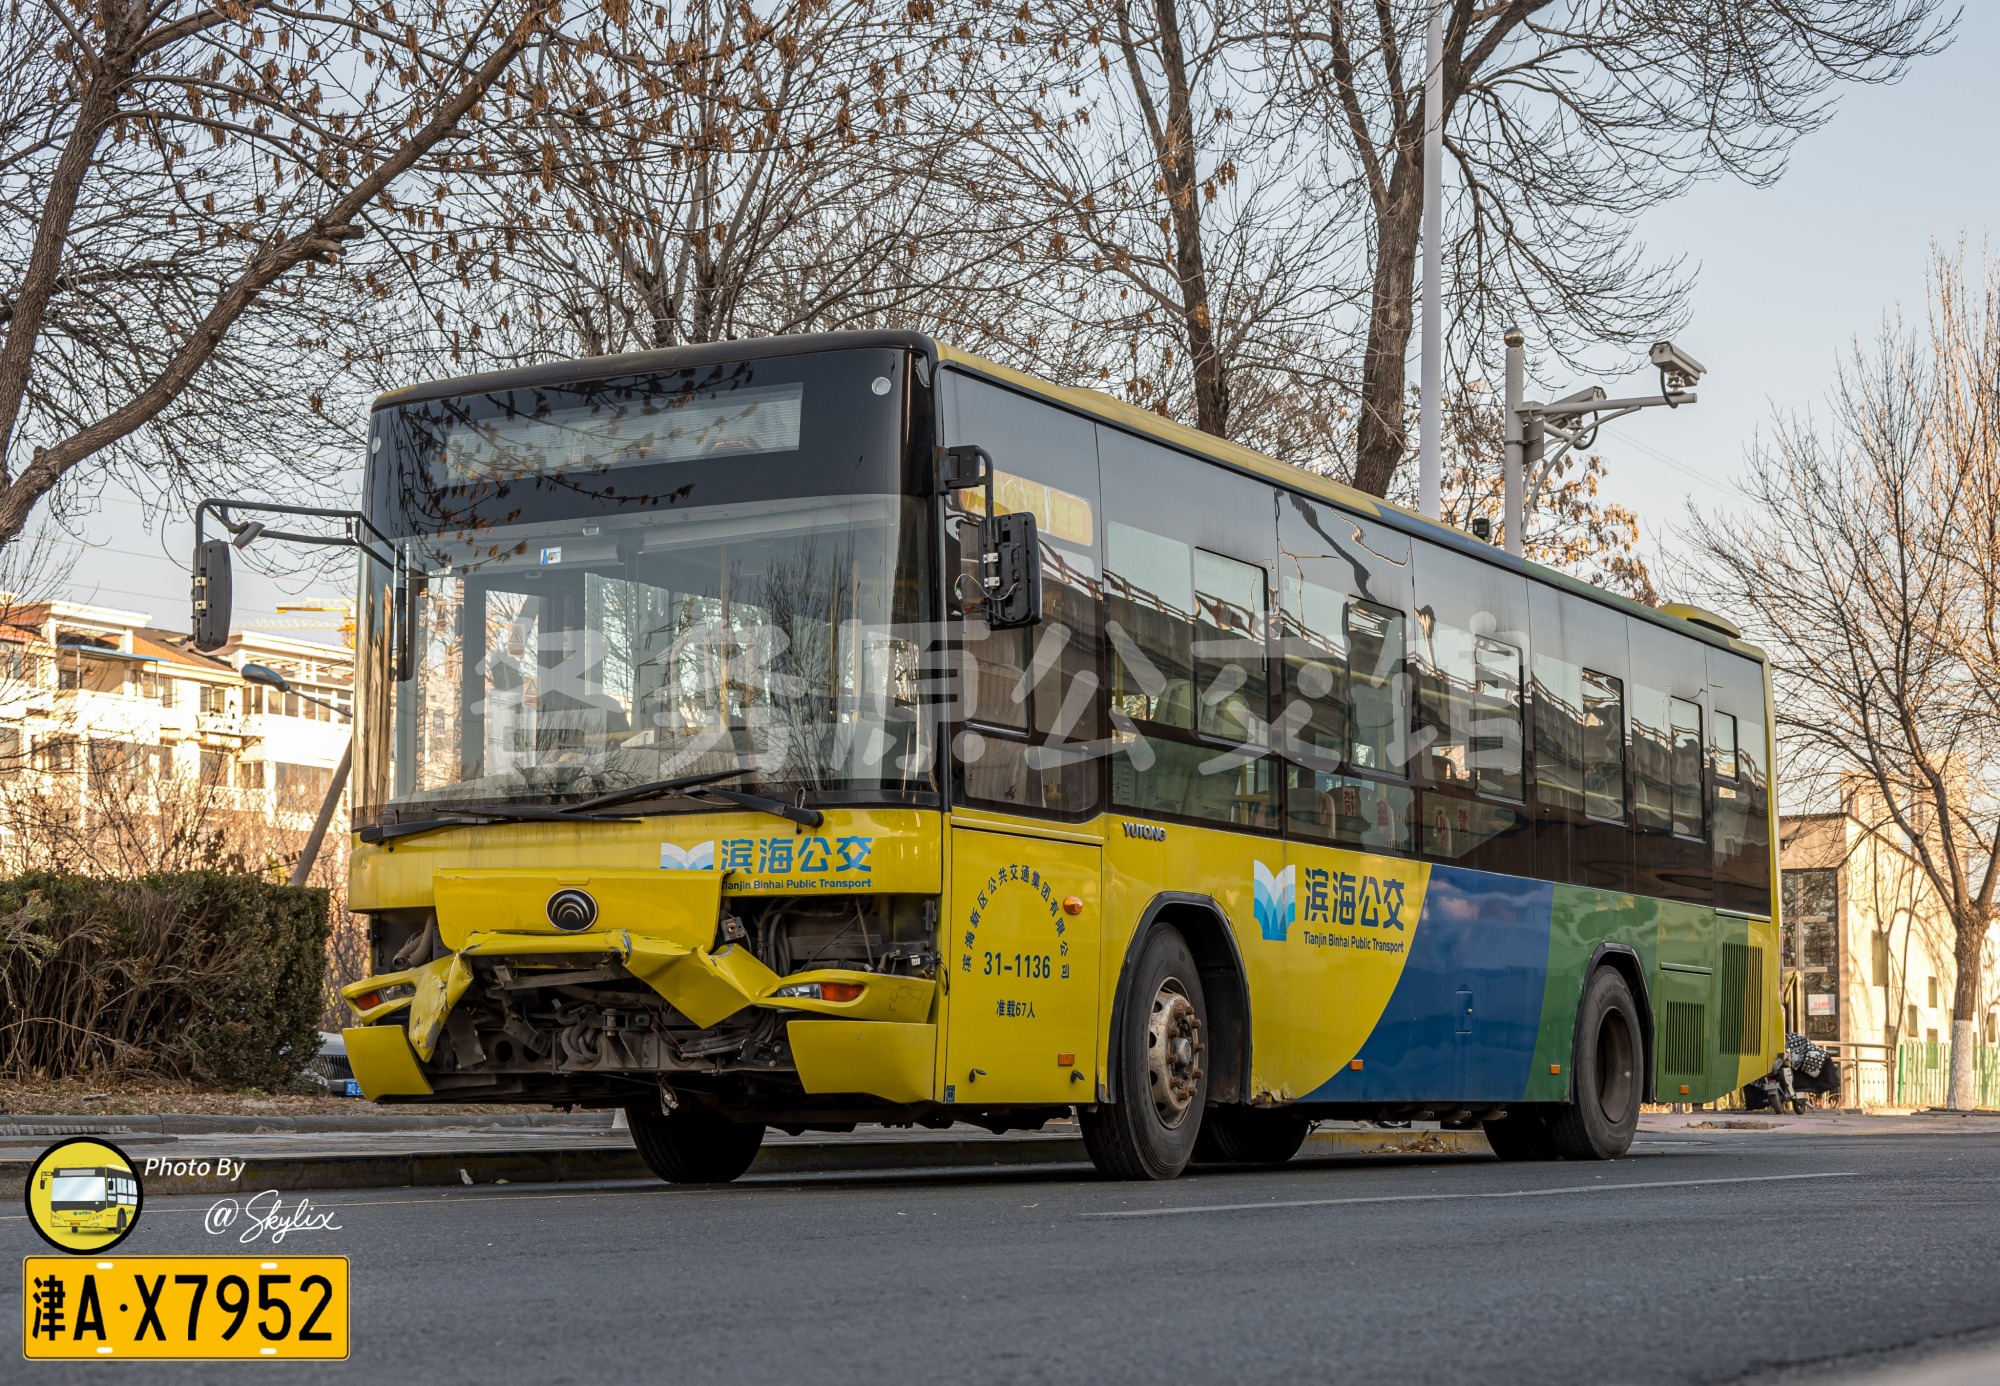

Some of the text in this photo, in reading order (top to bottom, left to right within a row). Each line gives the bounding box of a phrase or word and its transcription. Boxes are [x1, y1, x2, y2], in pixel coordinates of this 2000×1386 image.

[1122, 821, 1166, 842] YUTONG
[721, 836, 872, 873] 滨海公交
[753, 880, 784, 889] Binhai
[786, 879, 816, 889] Public
[819, 878, 872, 889] Transport
[1304, 867, 1404, 931] 滨海公交
[1304, 931, 1404, 955] Tianjin Binhai Public Transport
[983, 951, 1051, 979] 31-1136
[996, 998, 1036, 1019] 准载67人
